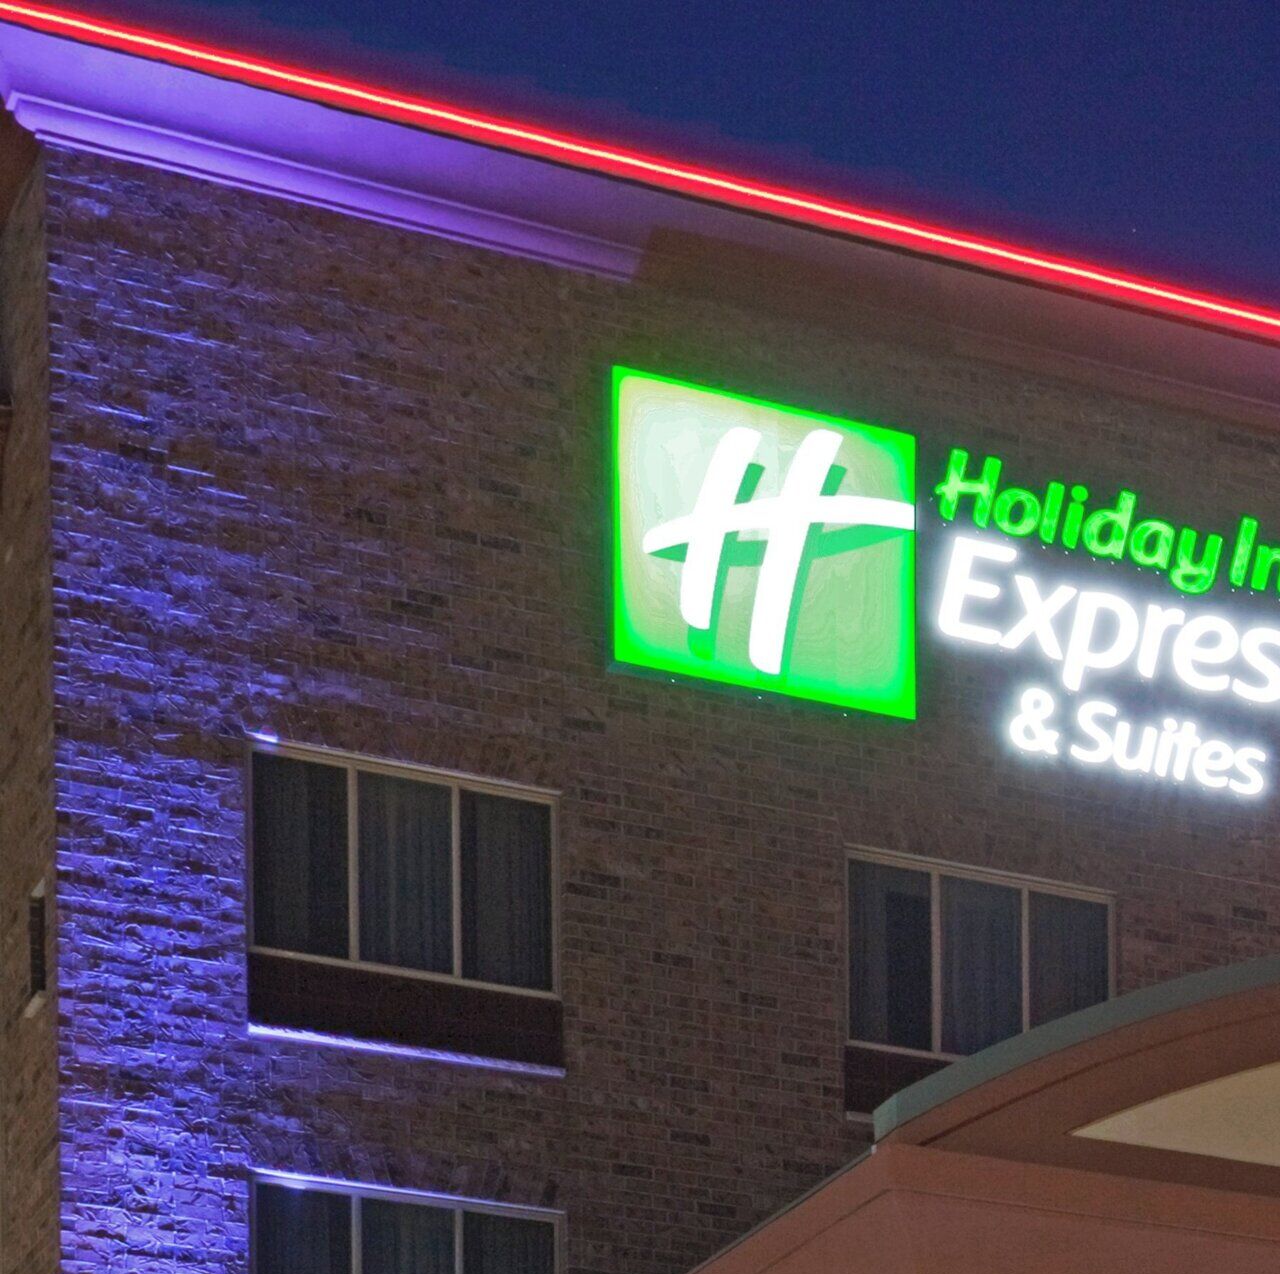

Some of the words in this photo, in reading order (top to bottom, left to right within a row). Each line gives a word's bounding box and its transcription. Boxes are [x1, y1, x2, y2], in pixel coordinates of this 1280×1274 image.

[935, 447, 1222, 595] Holiday
[1008, 688, 1060, 756] &
[1071, 701, 1269, 797] Suites
